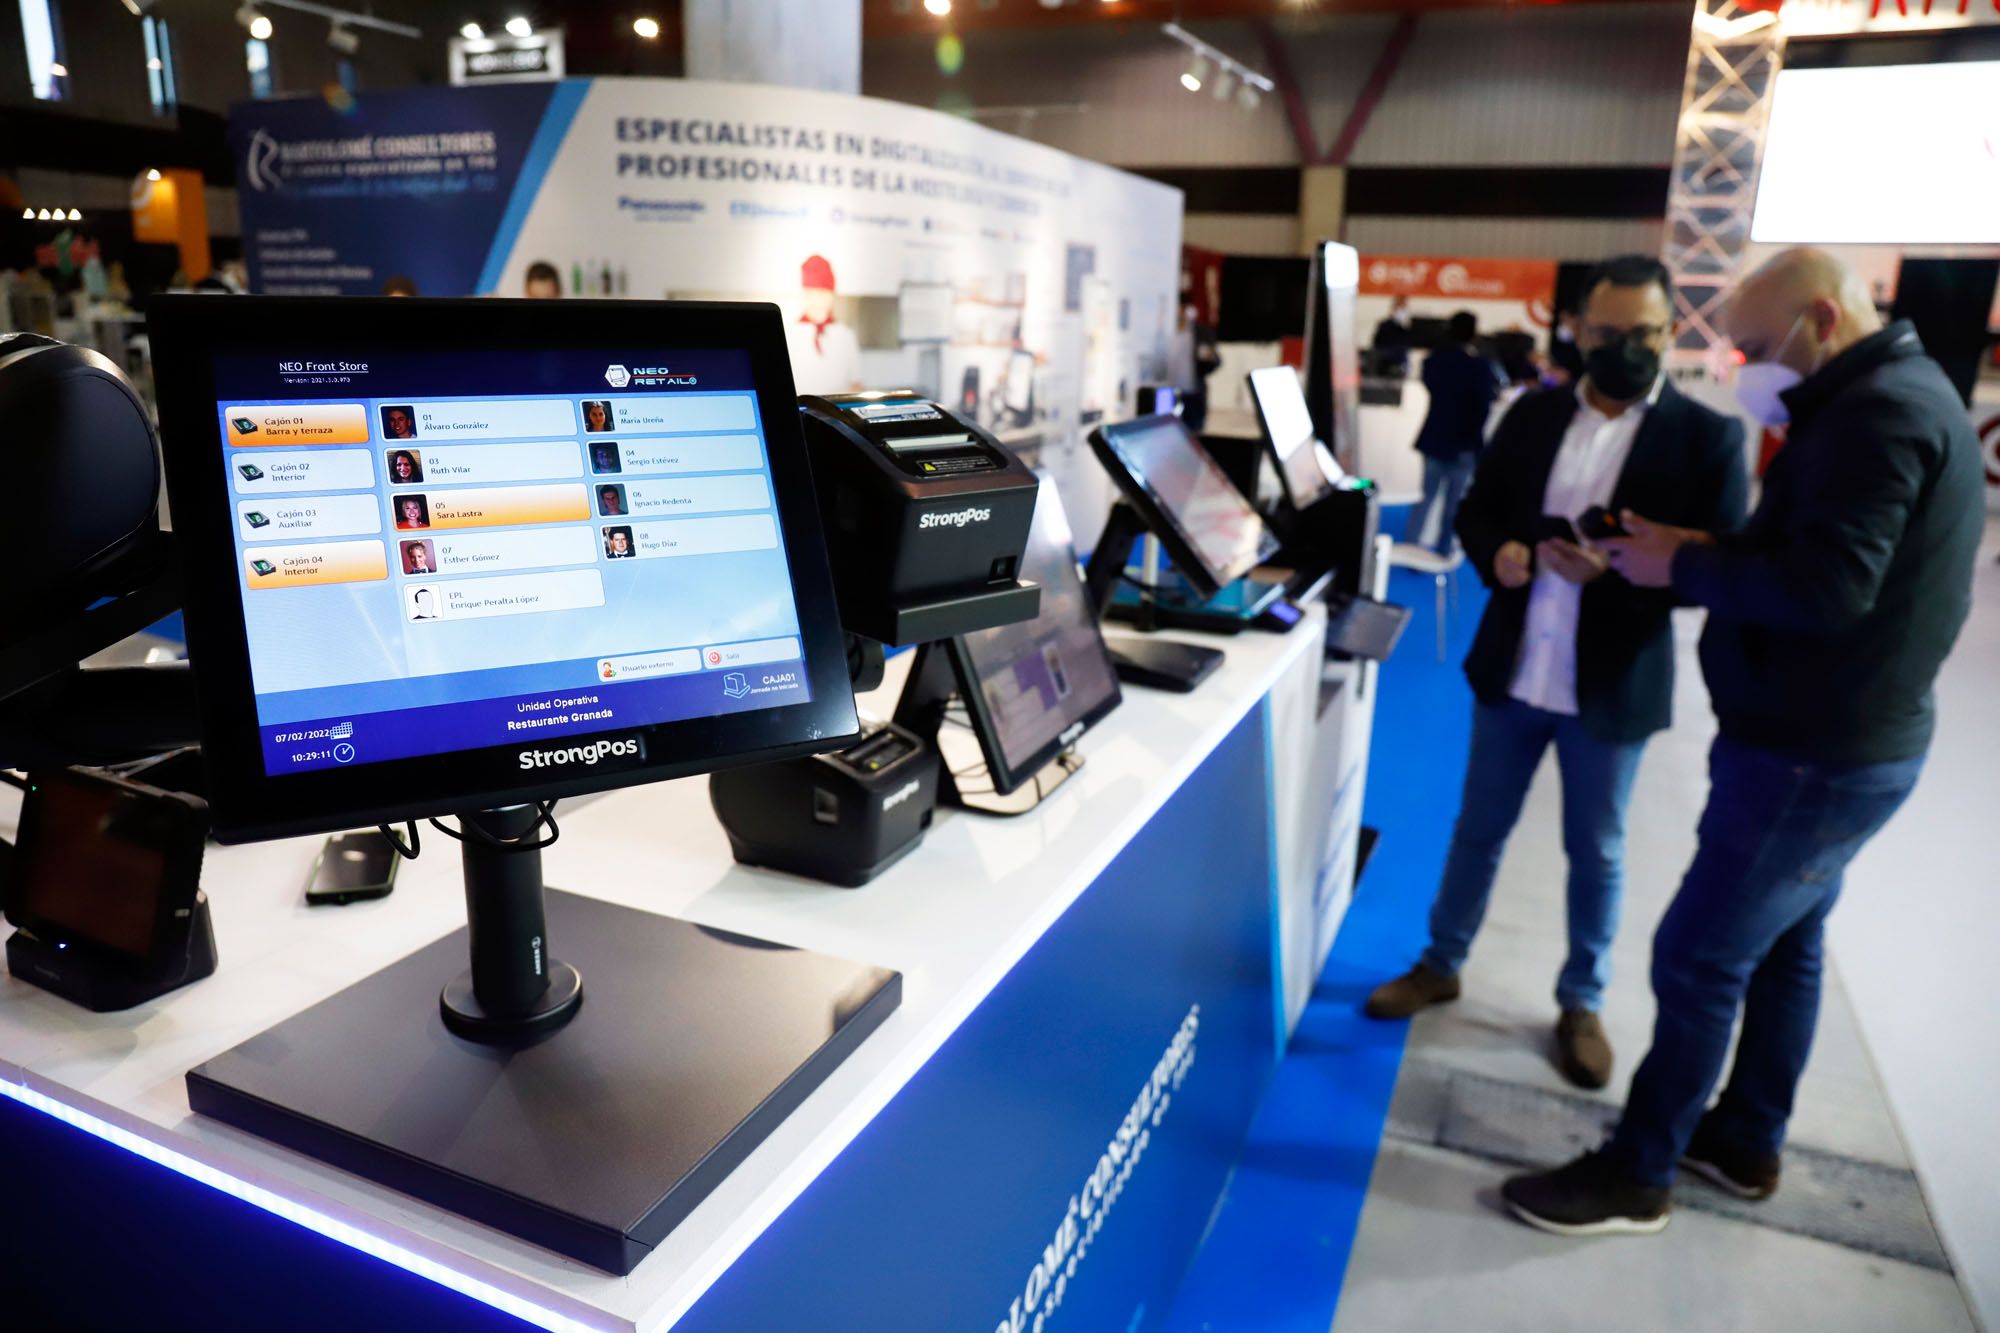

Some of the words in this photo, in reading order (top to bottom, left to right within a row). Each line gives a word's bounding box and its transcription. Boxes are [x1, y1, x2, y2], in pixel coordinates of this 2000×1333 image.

[616, 117, 826, 151] ESPECIALISTAS
[616, 153, 844, 186] PROFESIONALES
[280, 362, 302, 371] NEO
[306, 362, 335, 371] Front
[339, 361, 368, 371] Store
[633, 367, 669, 375] NEO
[264, 417, 291, 426] Cajón
[424, 421, 451, 431] Álvaro
[452, 420, 489, 430] González
[292, 428, 298, 436] y
[270, 462, 297, 472] Cajón
[299, 463, 310, 471] 02
[430, 467, 450, 475] Ruth
[271, 474, 306, 482] Interior
[277, 509, 303, 519] Cajón
[305, 509, 317, 517] 03
[457, 510, 483, 518] Lastra
[919, 507, 991, 529] StrongPos
[278, 520, 313, 529] Auxiliar
[441, 546, 452, 554] 07
[641, 542, 660, 550] Hugo
[283, 555, 310, 566] Cajón
[311, 556, 323, 564] 04
[443, 556, 469, 565] Esther
[472, 553, 500, 562] Gómez
[284, 567, 319, 576] Interior
[450, 601, 482, 610] Enrique
[484, 597, 514, 607] Peralta
[515, 595, 540, 605] López
[762, 672, 796, 685] CAJA01
[517, 700, 552, 713] Unidad
[553, 695, 599, 709] Operativa
[507, 714, 569, 731] Restaurante
[571, 708, 613, 722] Granada
[275, 729, 330, 743] 07/02/2022
[291, 750, 331, 762] 10:29:11
[518, 739, 638, 769] StrongPos
